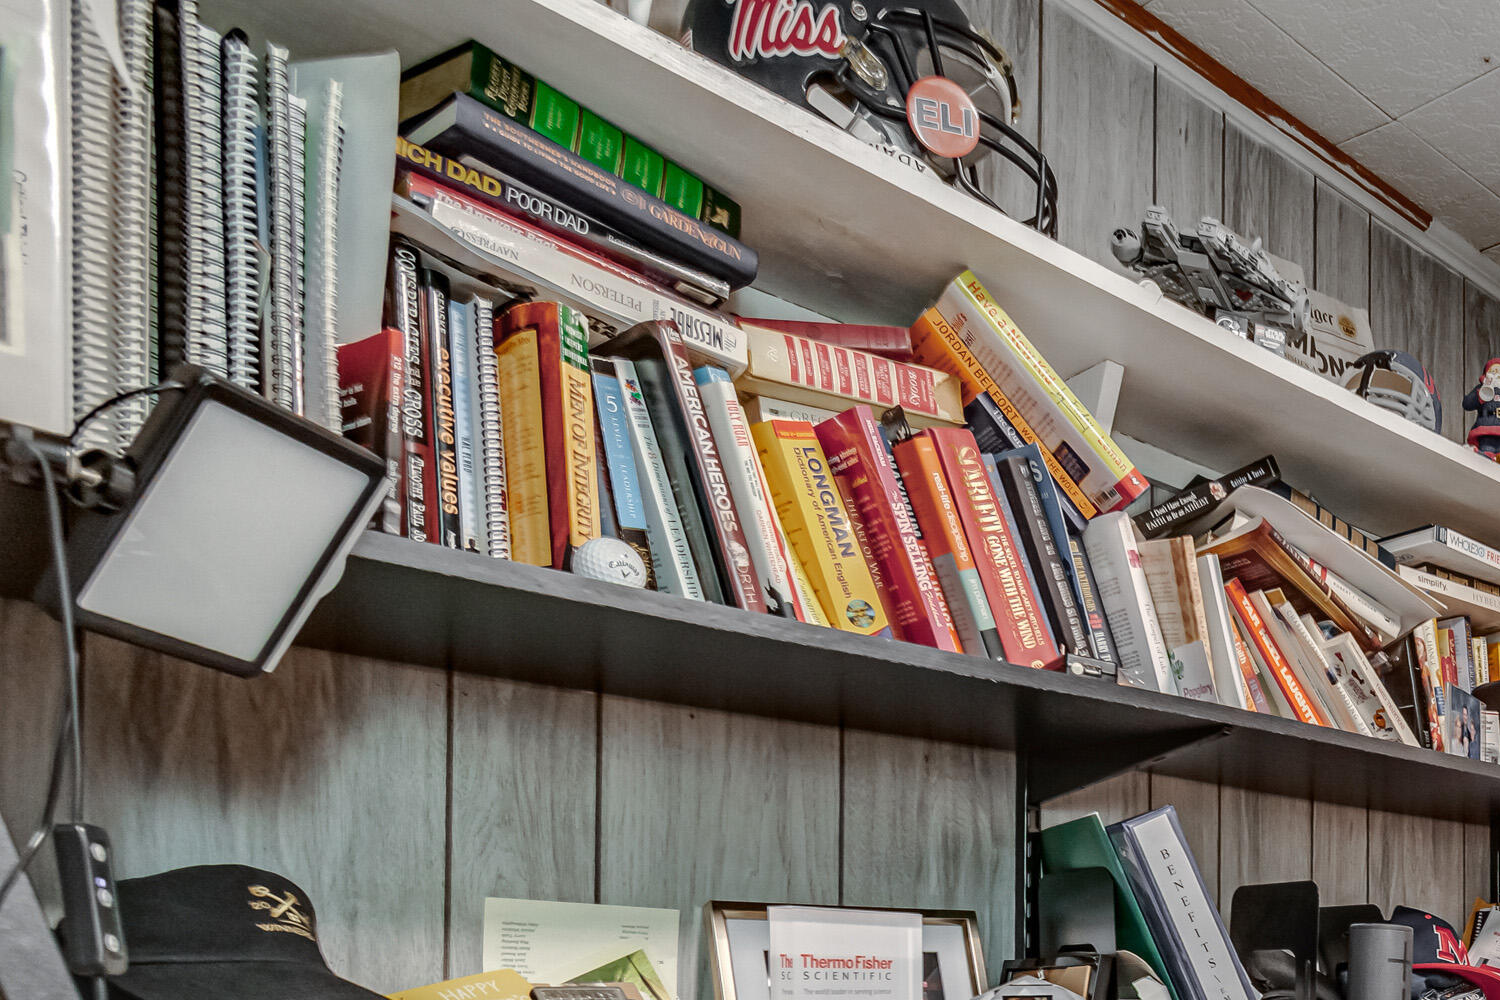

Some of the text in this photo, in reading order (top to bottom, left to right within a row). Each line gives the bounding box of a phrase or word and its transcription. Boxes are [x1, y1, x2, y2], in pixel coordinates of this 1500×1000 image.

[914, 97, 974, 138] ELI
[441, 158, 591, 236] DAD POOR DAD
[567, 270, 645, 314] PETERSON
[965, 279, 999, 317] Have
[565, 373, 589, 423] MEN
[602, 392, 619, 414] 5
[931, 316, 1019, 423] JORDAN BELFORT
[403, 387, 424, 438] CROSS
[433, 346, 460, 514] executive values
[570, 421, 588, 450] OF
[672, 351, 739, 535] AMERICAN HEROES
[723, 398, 742, 424] HOLY
[730, 422, 750, 449] ROAR
[408, 455, 427, 525] TIMOTHY PAUL
[570, 448, 598, 539] INTEGRITY
[801, 444, 855, 559] LONGMAN
[1043, 456, 1078, 498] THE WOLF
[792, 446, 853, 599] Dictionary of American English
[844, 496, 886, 590] THE ART OF WAR
[890, 499, 914, 536] SPIN
[902, 533, 933, 591] SELLING
[930, 469, 971, 562] real-life discipleship
[1144, 514, 1167, 531] FAITH
[1182, 496, 1209, 514] ATHEIST
[666, 517, 699, 600] LEADERSHIP
[982, 532, 1037, 651] GONE WITH THE WIND
[1238, 595, 1284, 667] TAR HEEL
[1160, 848, 1217, 969] BENEFITS
[801, 953, 893, 970] Thermo Fisher
[803, 971, 892, 981] SCIENTIFIC
[1433, 924, 1470, 966] M
